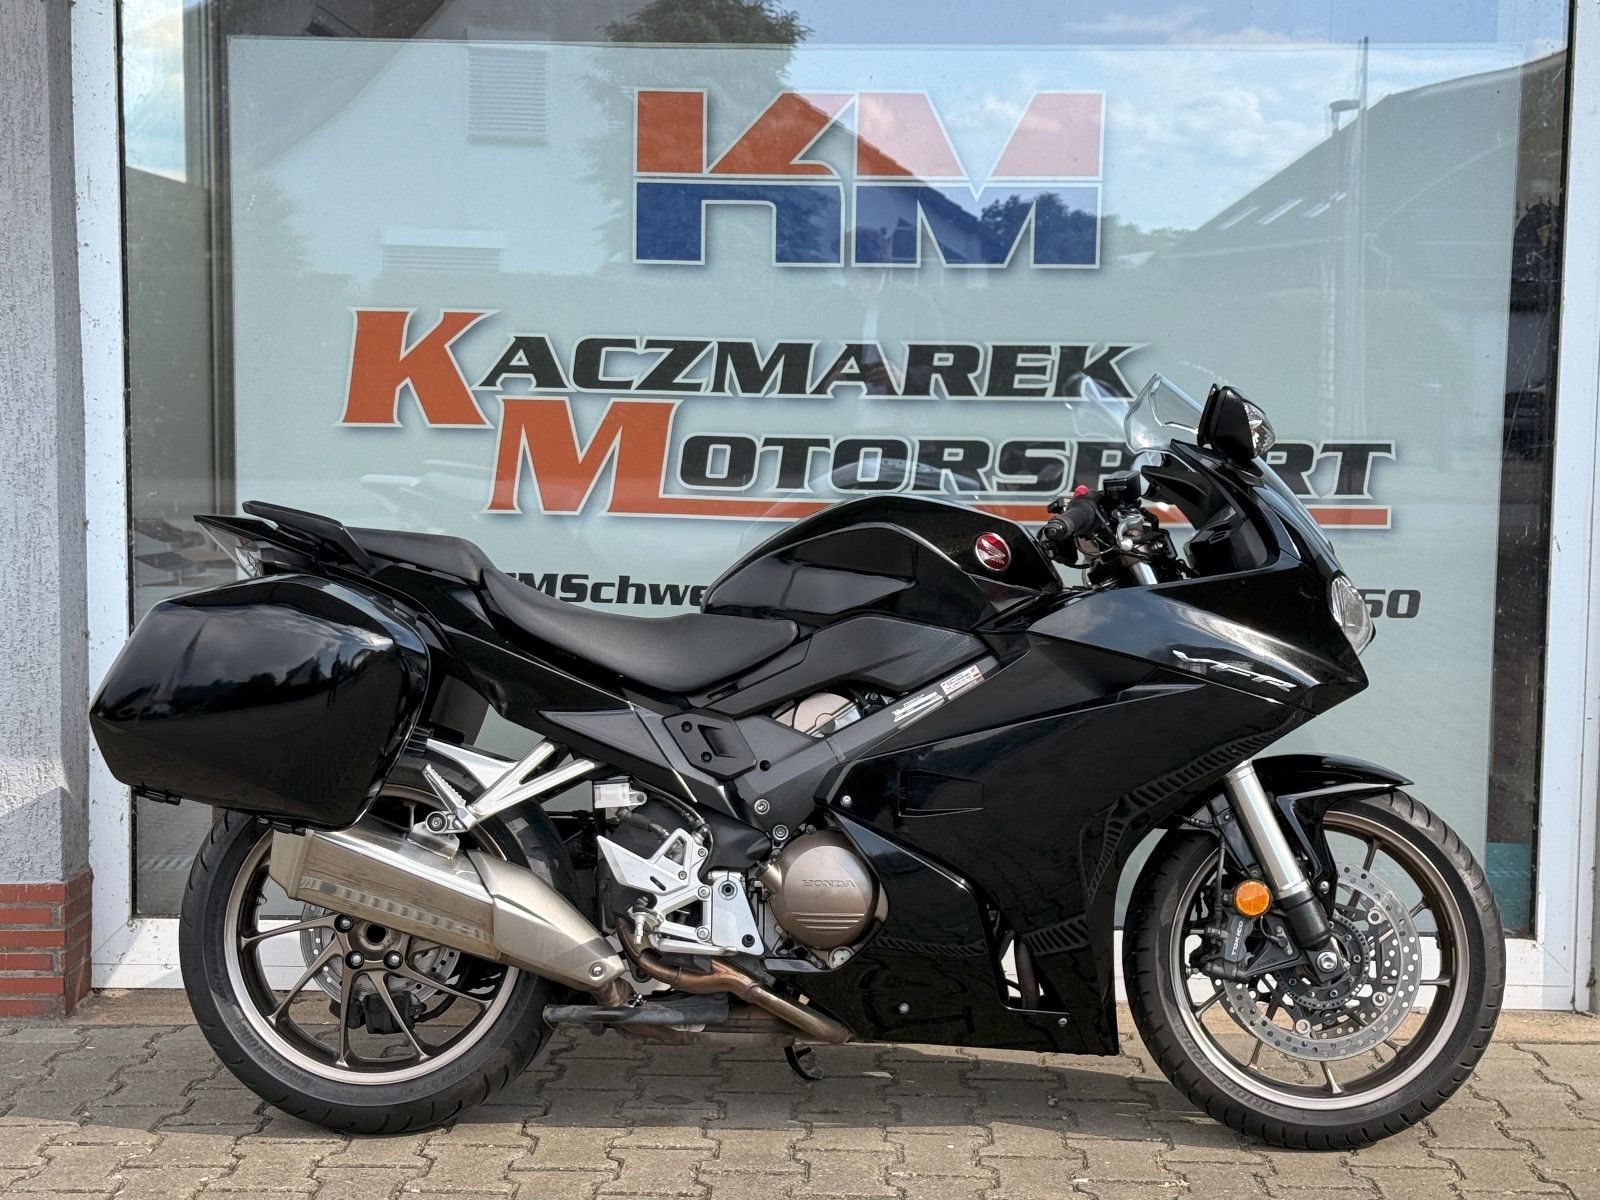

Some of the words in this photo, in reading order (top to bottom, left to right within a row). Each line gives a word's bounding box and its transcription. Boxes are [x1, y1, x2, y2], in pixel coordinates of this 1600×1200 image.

[634, 87, 1107, 270] KM
[338, 306, 1148, 430] KACZMAREK
[483, 396, 1394, 516] MOTORSPRT
[504, 572, 709, 607] MSchwe
[801, 879, 857, 888] HONDA
